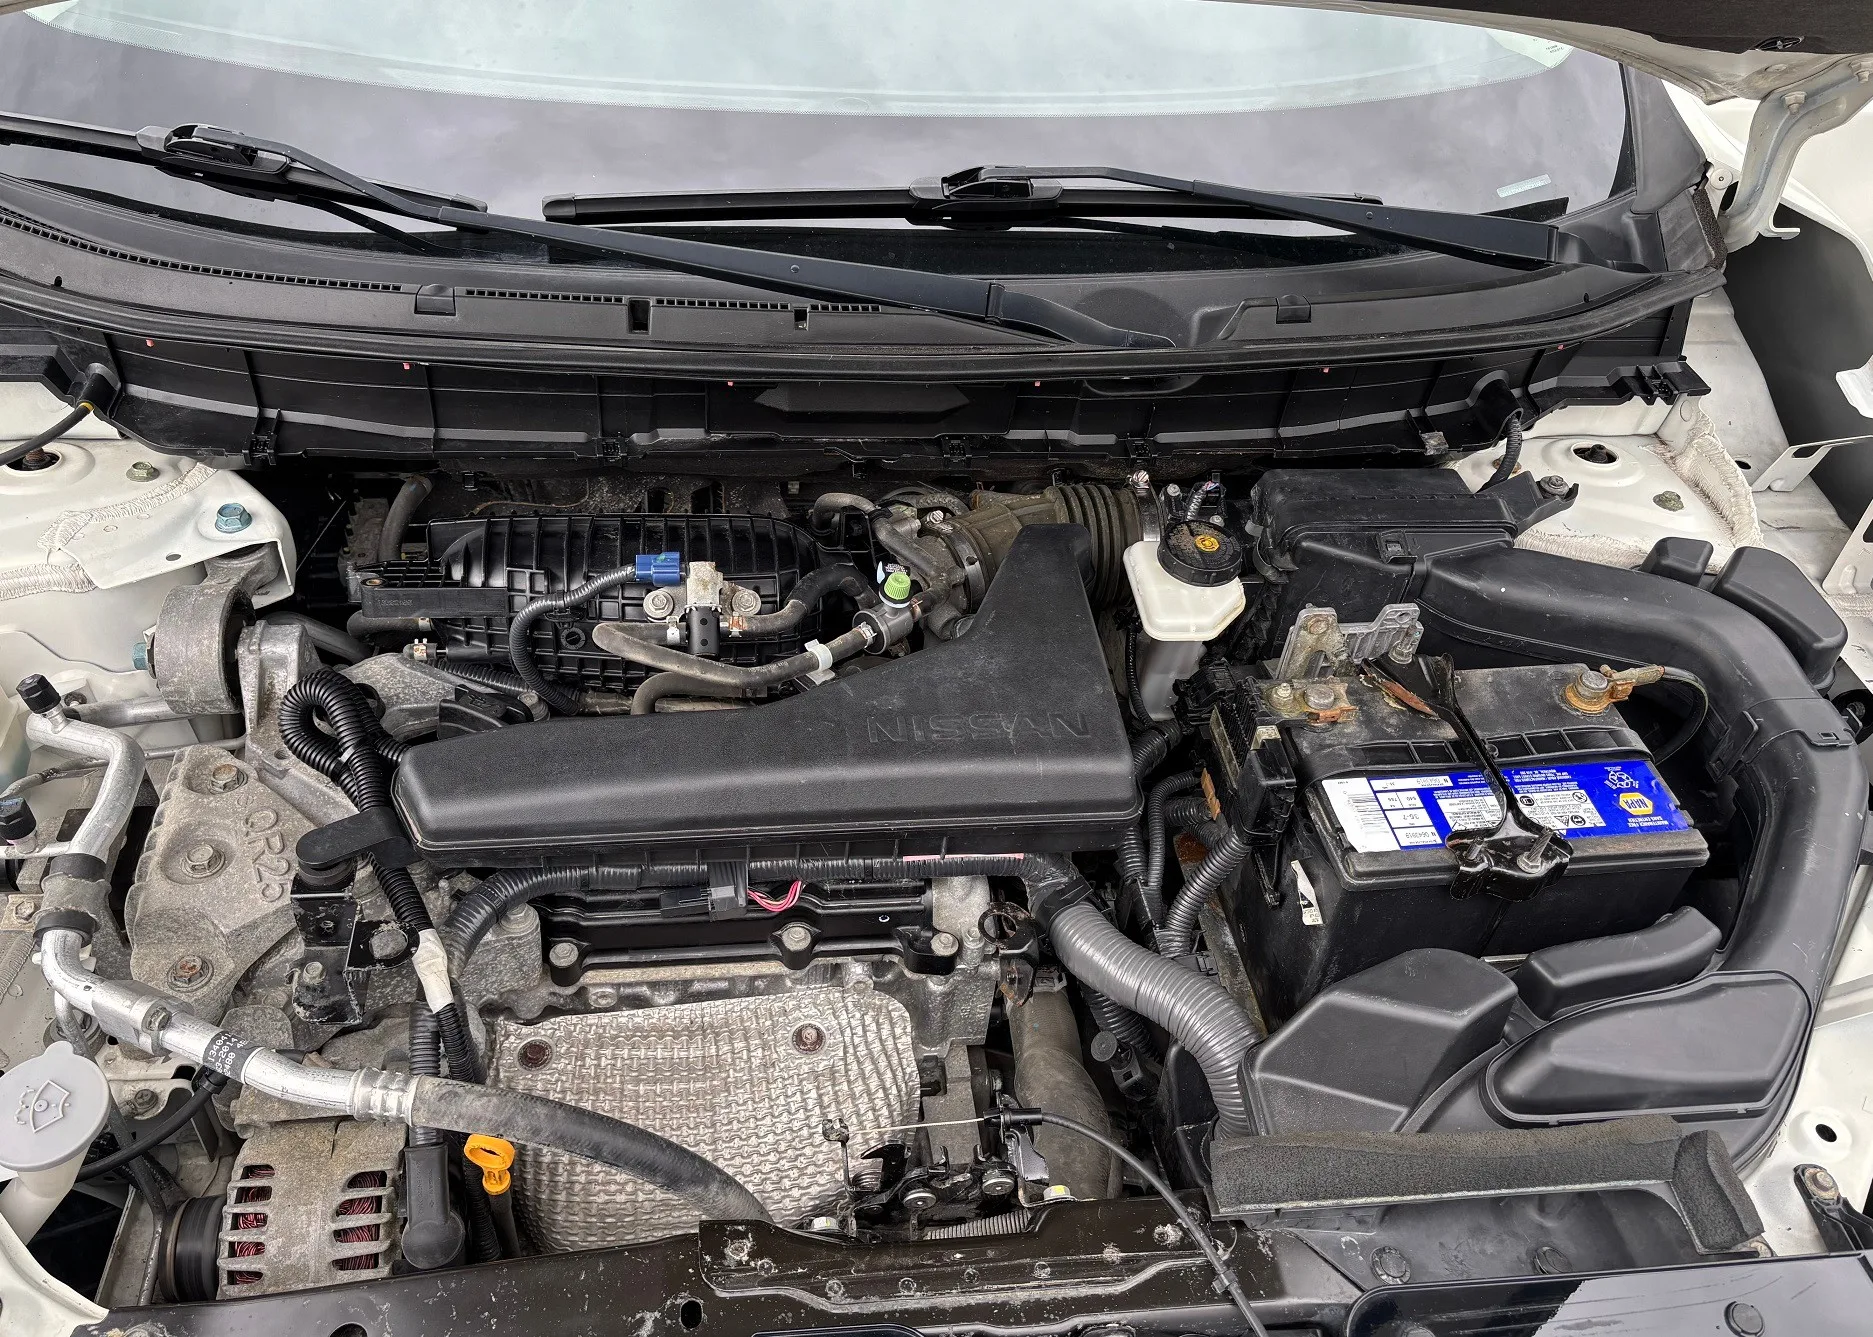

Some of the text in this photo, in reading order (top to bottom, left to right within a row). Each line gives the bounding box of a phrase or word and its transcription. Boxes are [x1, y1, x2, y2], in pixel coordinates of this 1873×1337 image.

[867, 712, 1091, 742] NISSAN
[1622, 798, 1649, 810] NAPA
[243, 806, 291, 904] QR25
